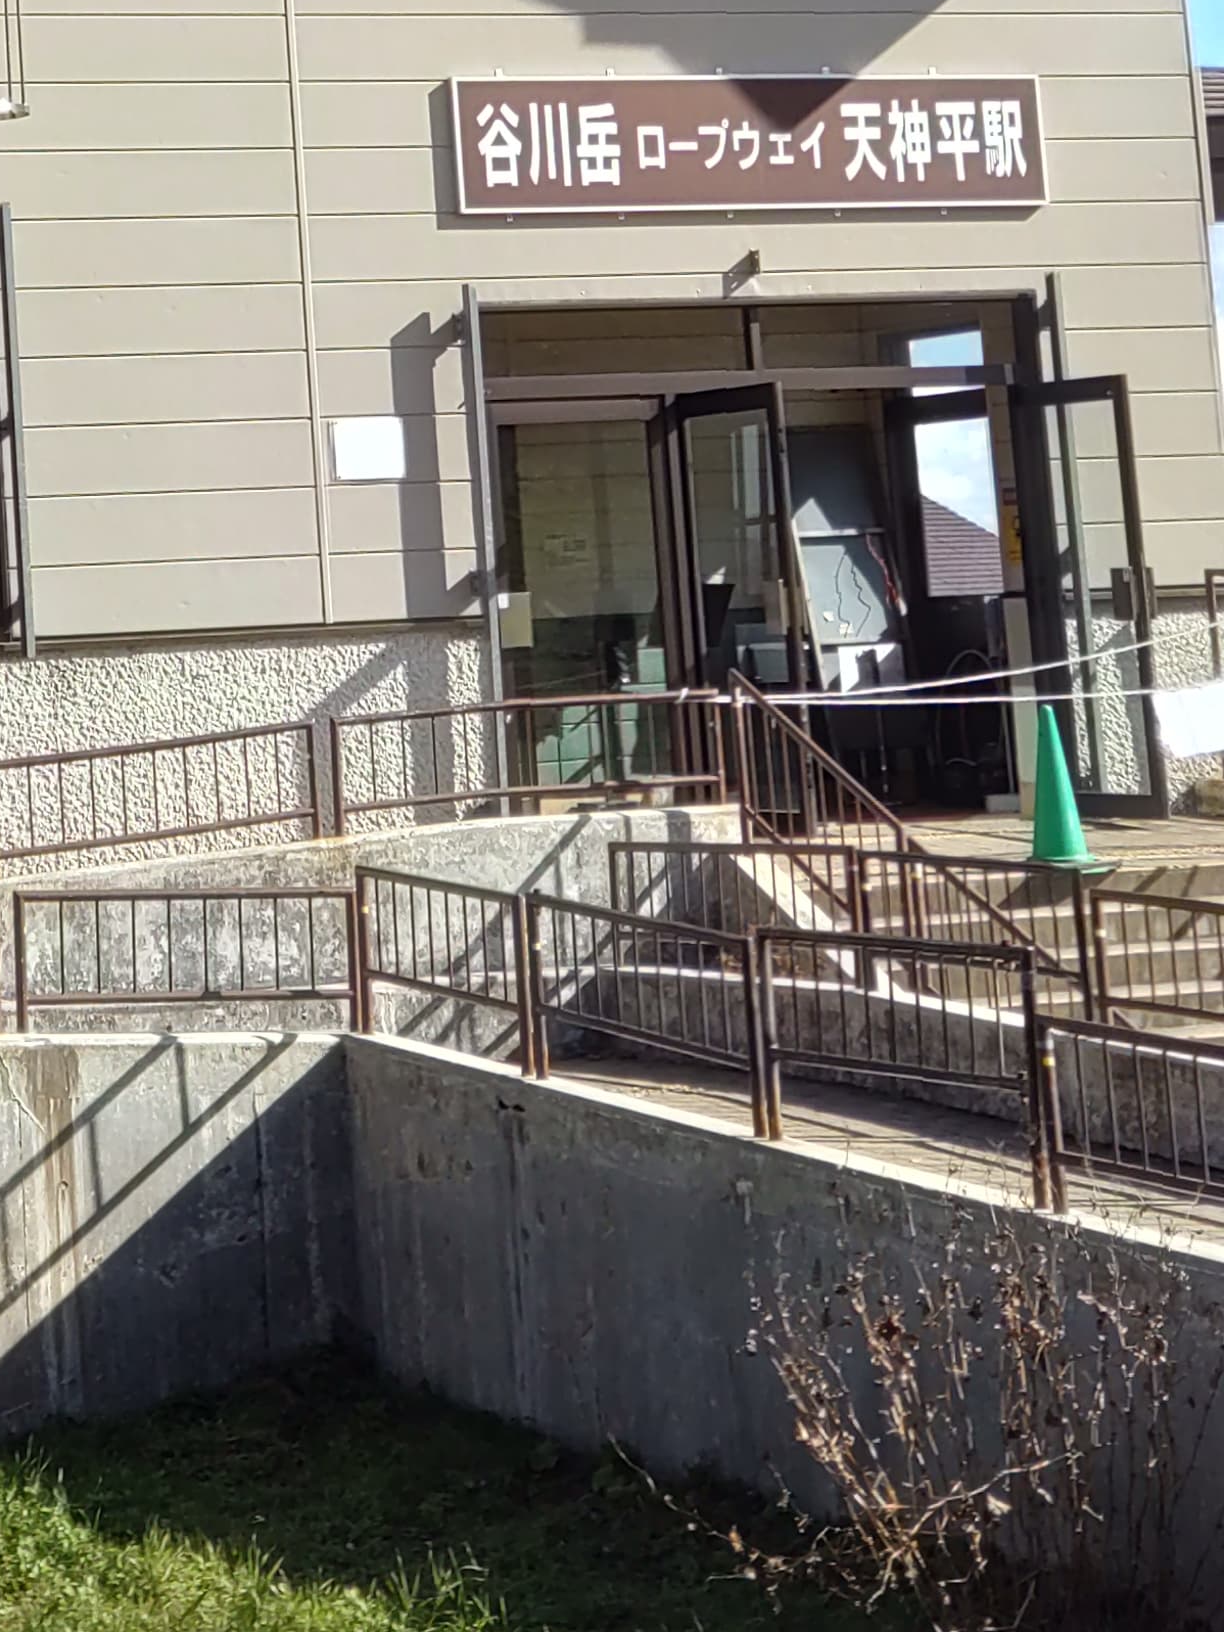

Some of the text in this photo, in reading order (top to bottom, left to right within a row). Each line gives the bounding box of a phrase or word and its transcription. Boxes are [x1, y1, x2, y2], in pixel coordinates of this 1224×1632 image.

[476, 98, 1028, 188] 谷川岳 ロープウェイ 天神平駅
